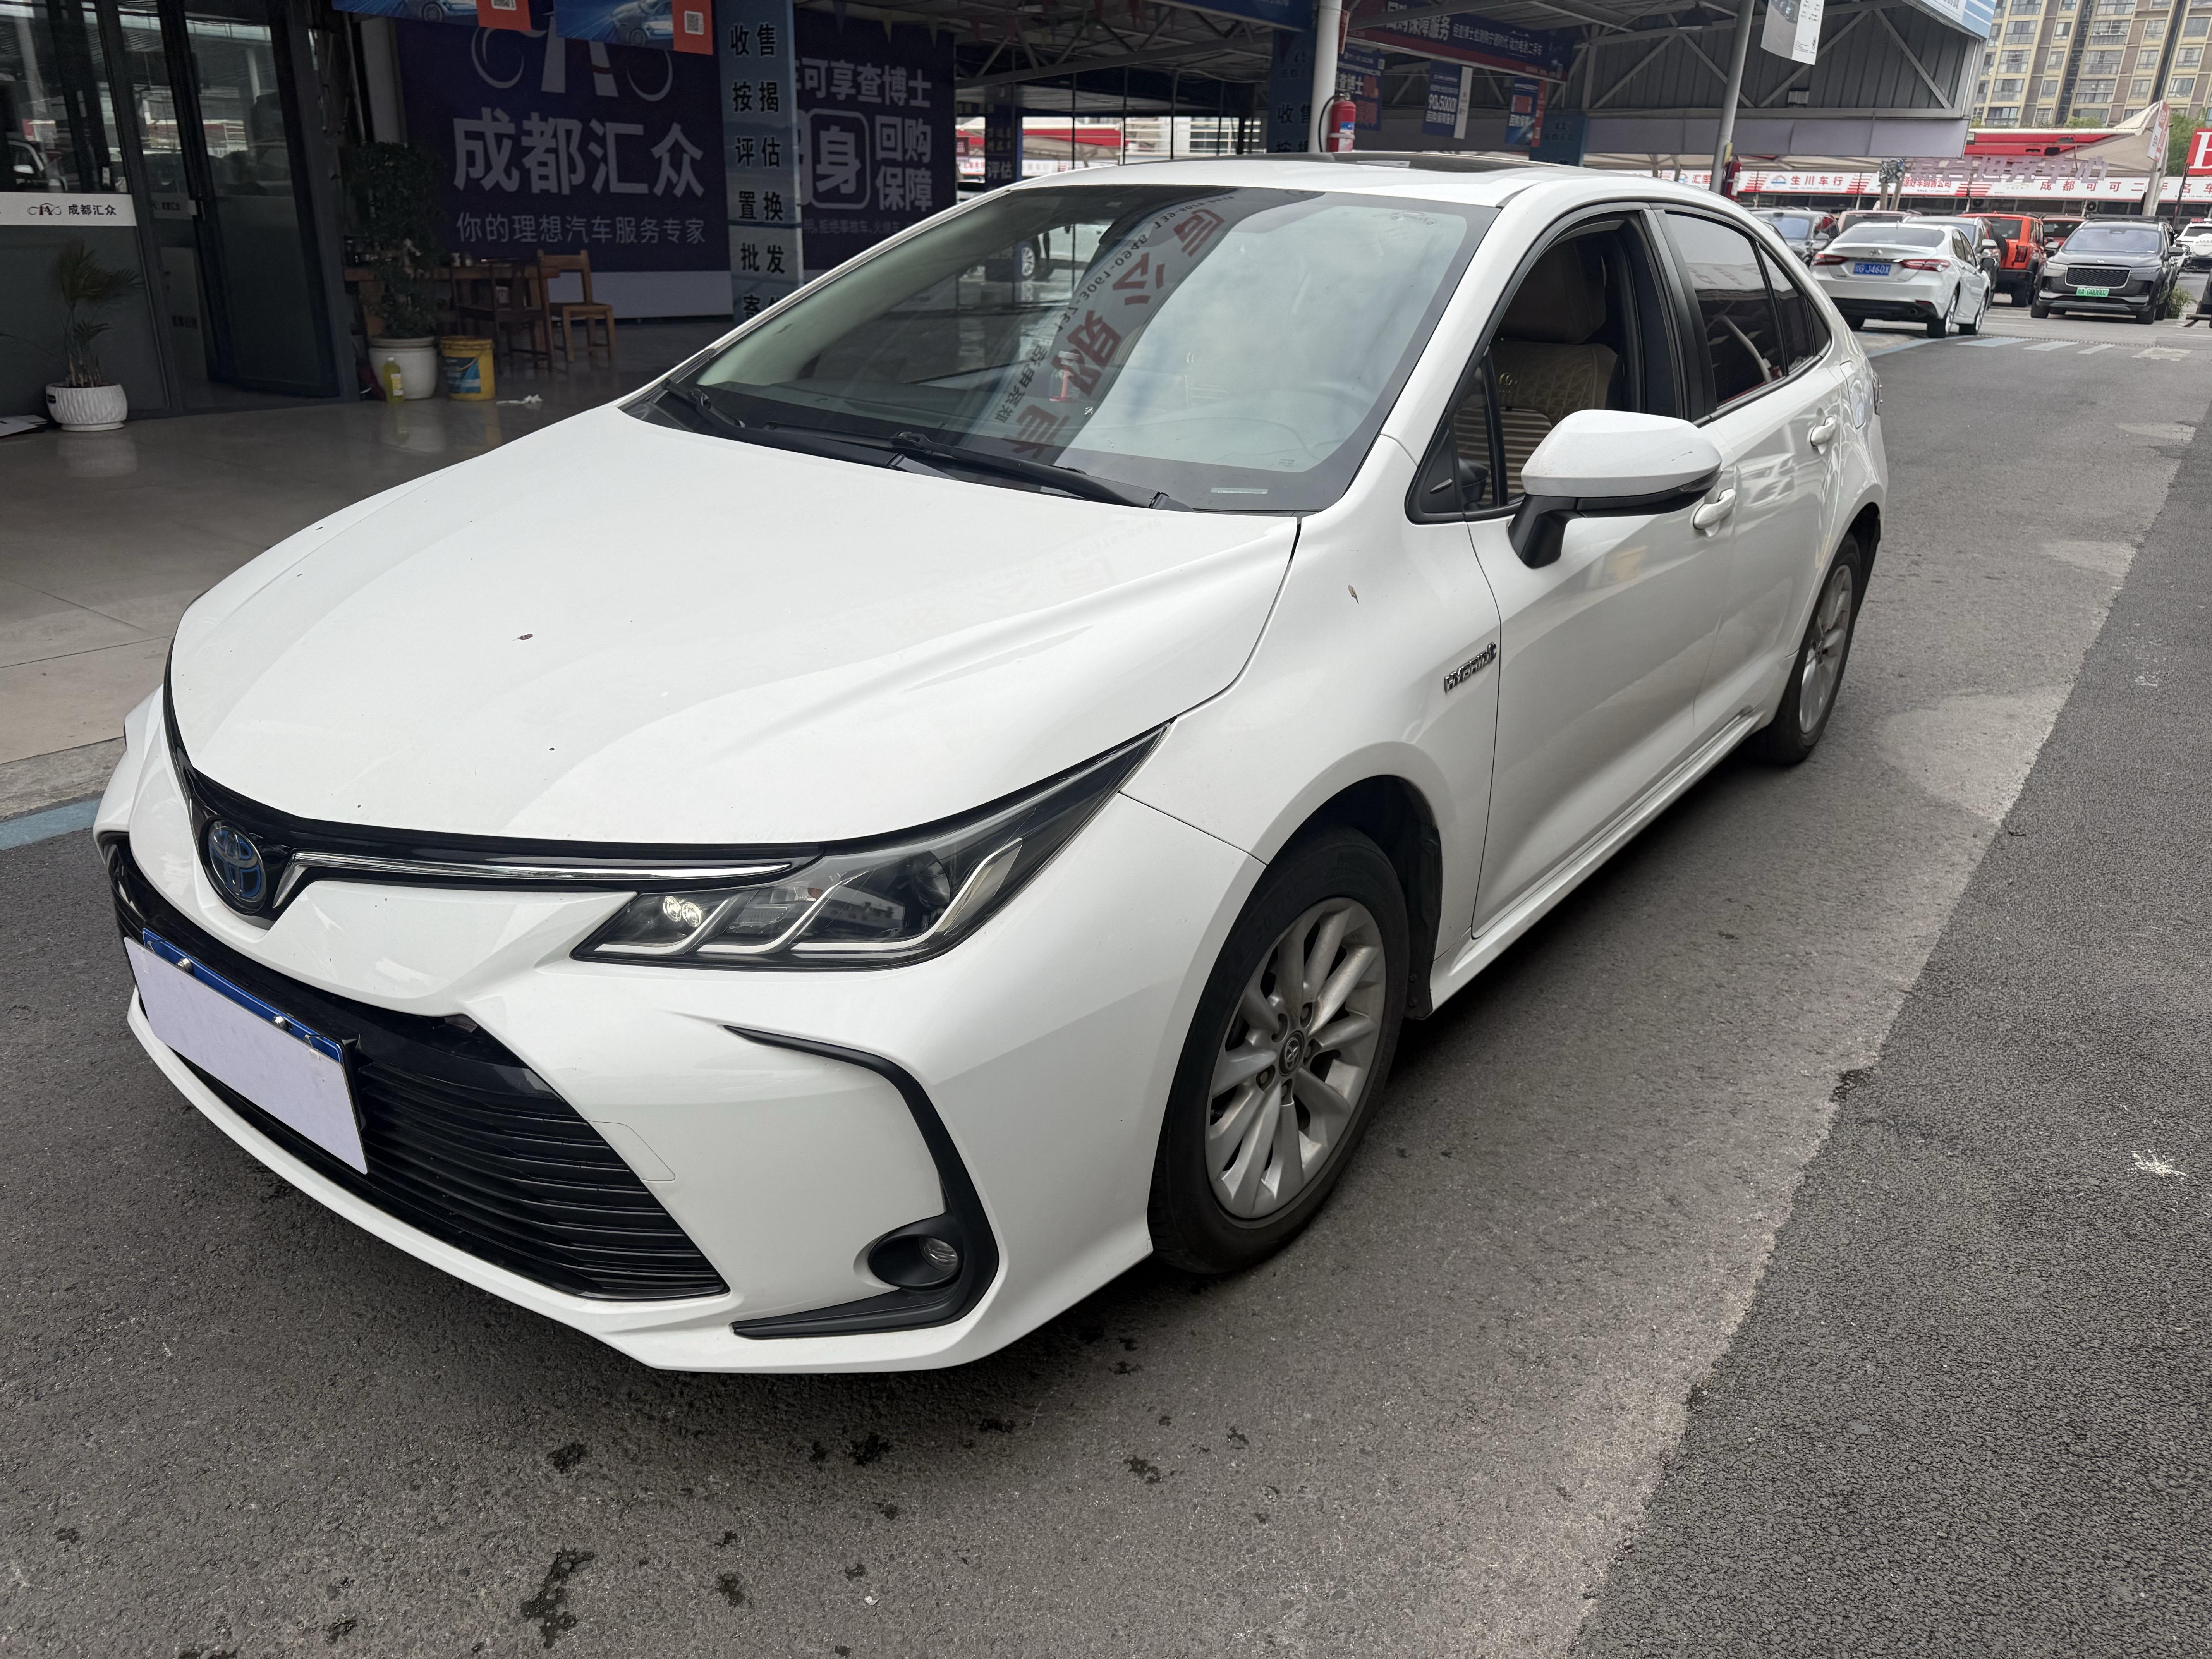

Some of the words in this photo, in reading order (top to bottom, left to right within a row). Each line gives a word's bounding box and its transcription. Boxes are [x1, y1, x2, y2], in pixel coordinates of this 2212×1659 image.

[730, 23, 776, 58] 收售
[733, 81, 779, 113] 按揭
[452, 106, 705, 198] 成都汇众
[735, 137, 781, 167] 评估
[874, 115, 932, 164] 回购
[815, 125, 862, 194] 身
[875, 164, 933, 211] 保障
[1790, 175, 1843, 186] 生川车行
[68, 204, 117, 216] 成都汇众
[738, 191, 784, 222] 置换
[456, 212, 706, 244] 你的理想汽车服务专家
[740, 243, 785, 275] 批发
[1444, 650, 1490, 694] HYBRID
